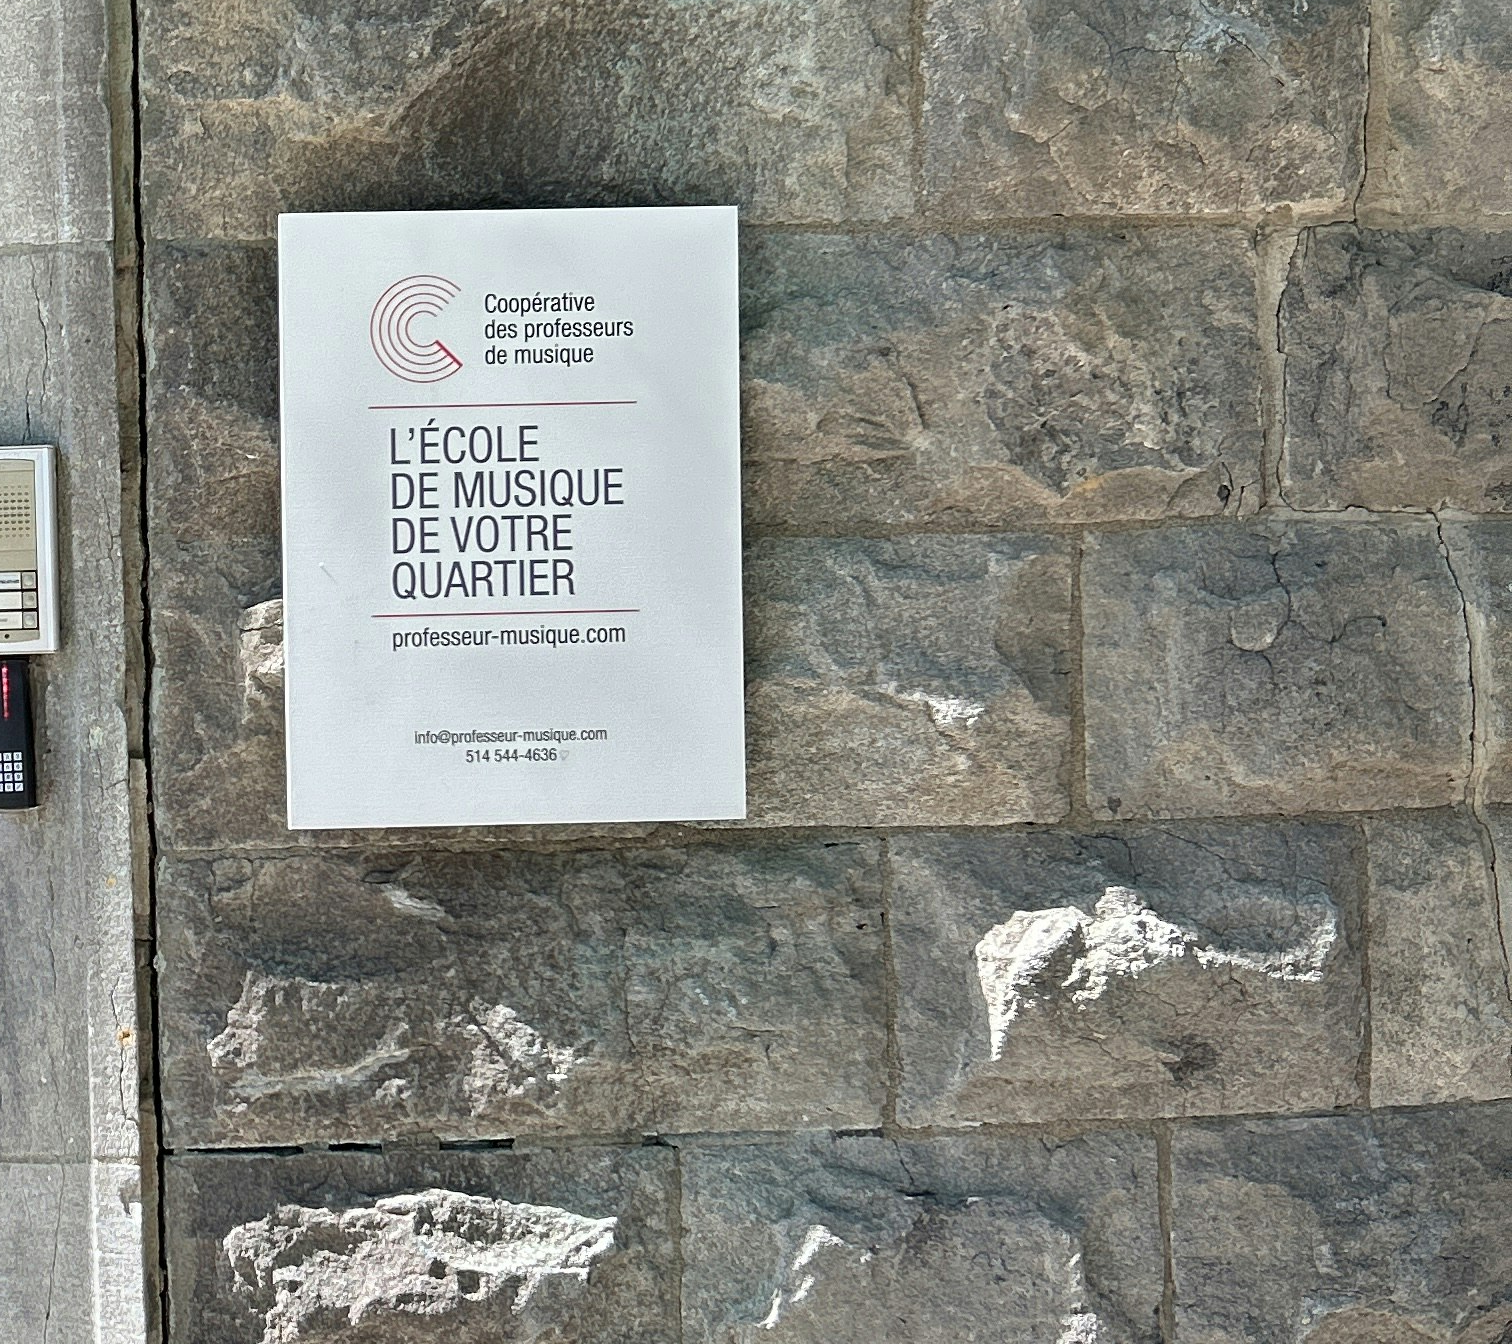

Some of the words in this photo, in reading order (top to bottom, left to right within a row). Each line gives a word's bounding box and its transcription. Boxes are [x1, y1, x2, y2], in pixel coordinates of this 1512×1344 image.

[484, 292, 595, 317] Coopérative
[484, 319, 518, 339] des
[524, 318, 634, 342] professeurs
[484, 345, 508, 365] de
[514, 343, 594, 367] musique
[390, 417, 540, 465] L'ÉCOLE
[391, 472, 440, 510] DE
[454, 468, 624, 509] MUSIQUE
[392, 516, 440, 554] DE
[449, 513, 573, 553] VOTRE
[392, 558, 575, 600] QUARTIER
[392, 625, 626, 651] professeur-musique.com
[414, 728, 608, 747] info@professeur-musique.com
[465, 749, 490, 763] 514
[493, 747, 558, 763] 544-4636
